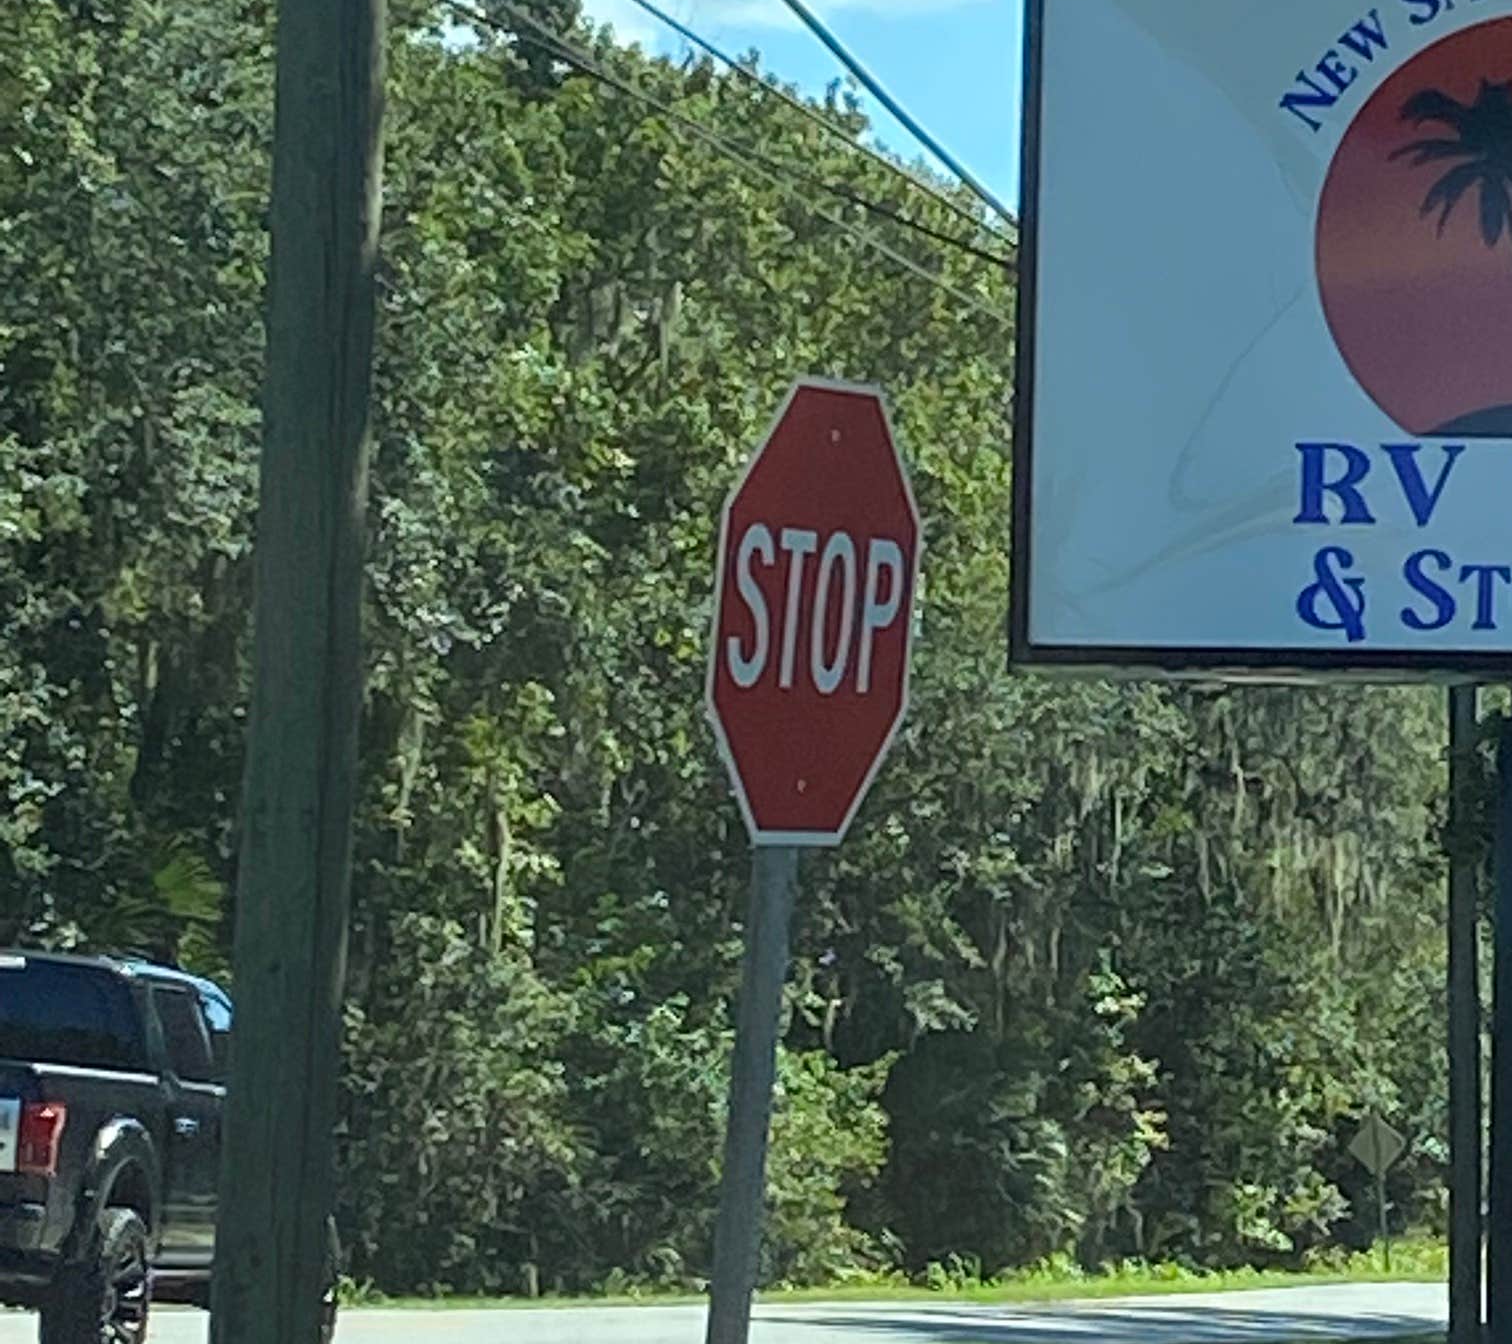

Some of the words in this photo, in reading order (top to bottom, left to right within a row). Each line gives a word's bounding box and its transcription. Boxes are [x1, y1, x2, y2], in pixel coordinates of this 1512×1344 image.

[1279, 9, 1391, 132] NEW
[1292, 442, 1466, 528] RV
[727, 522, 904, 695] STOP
[1296, 546, 1366, 643] &
